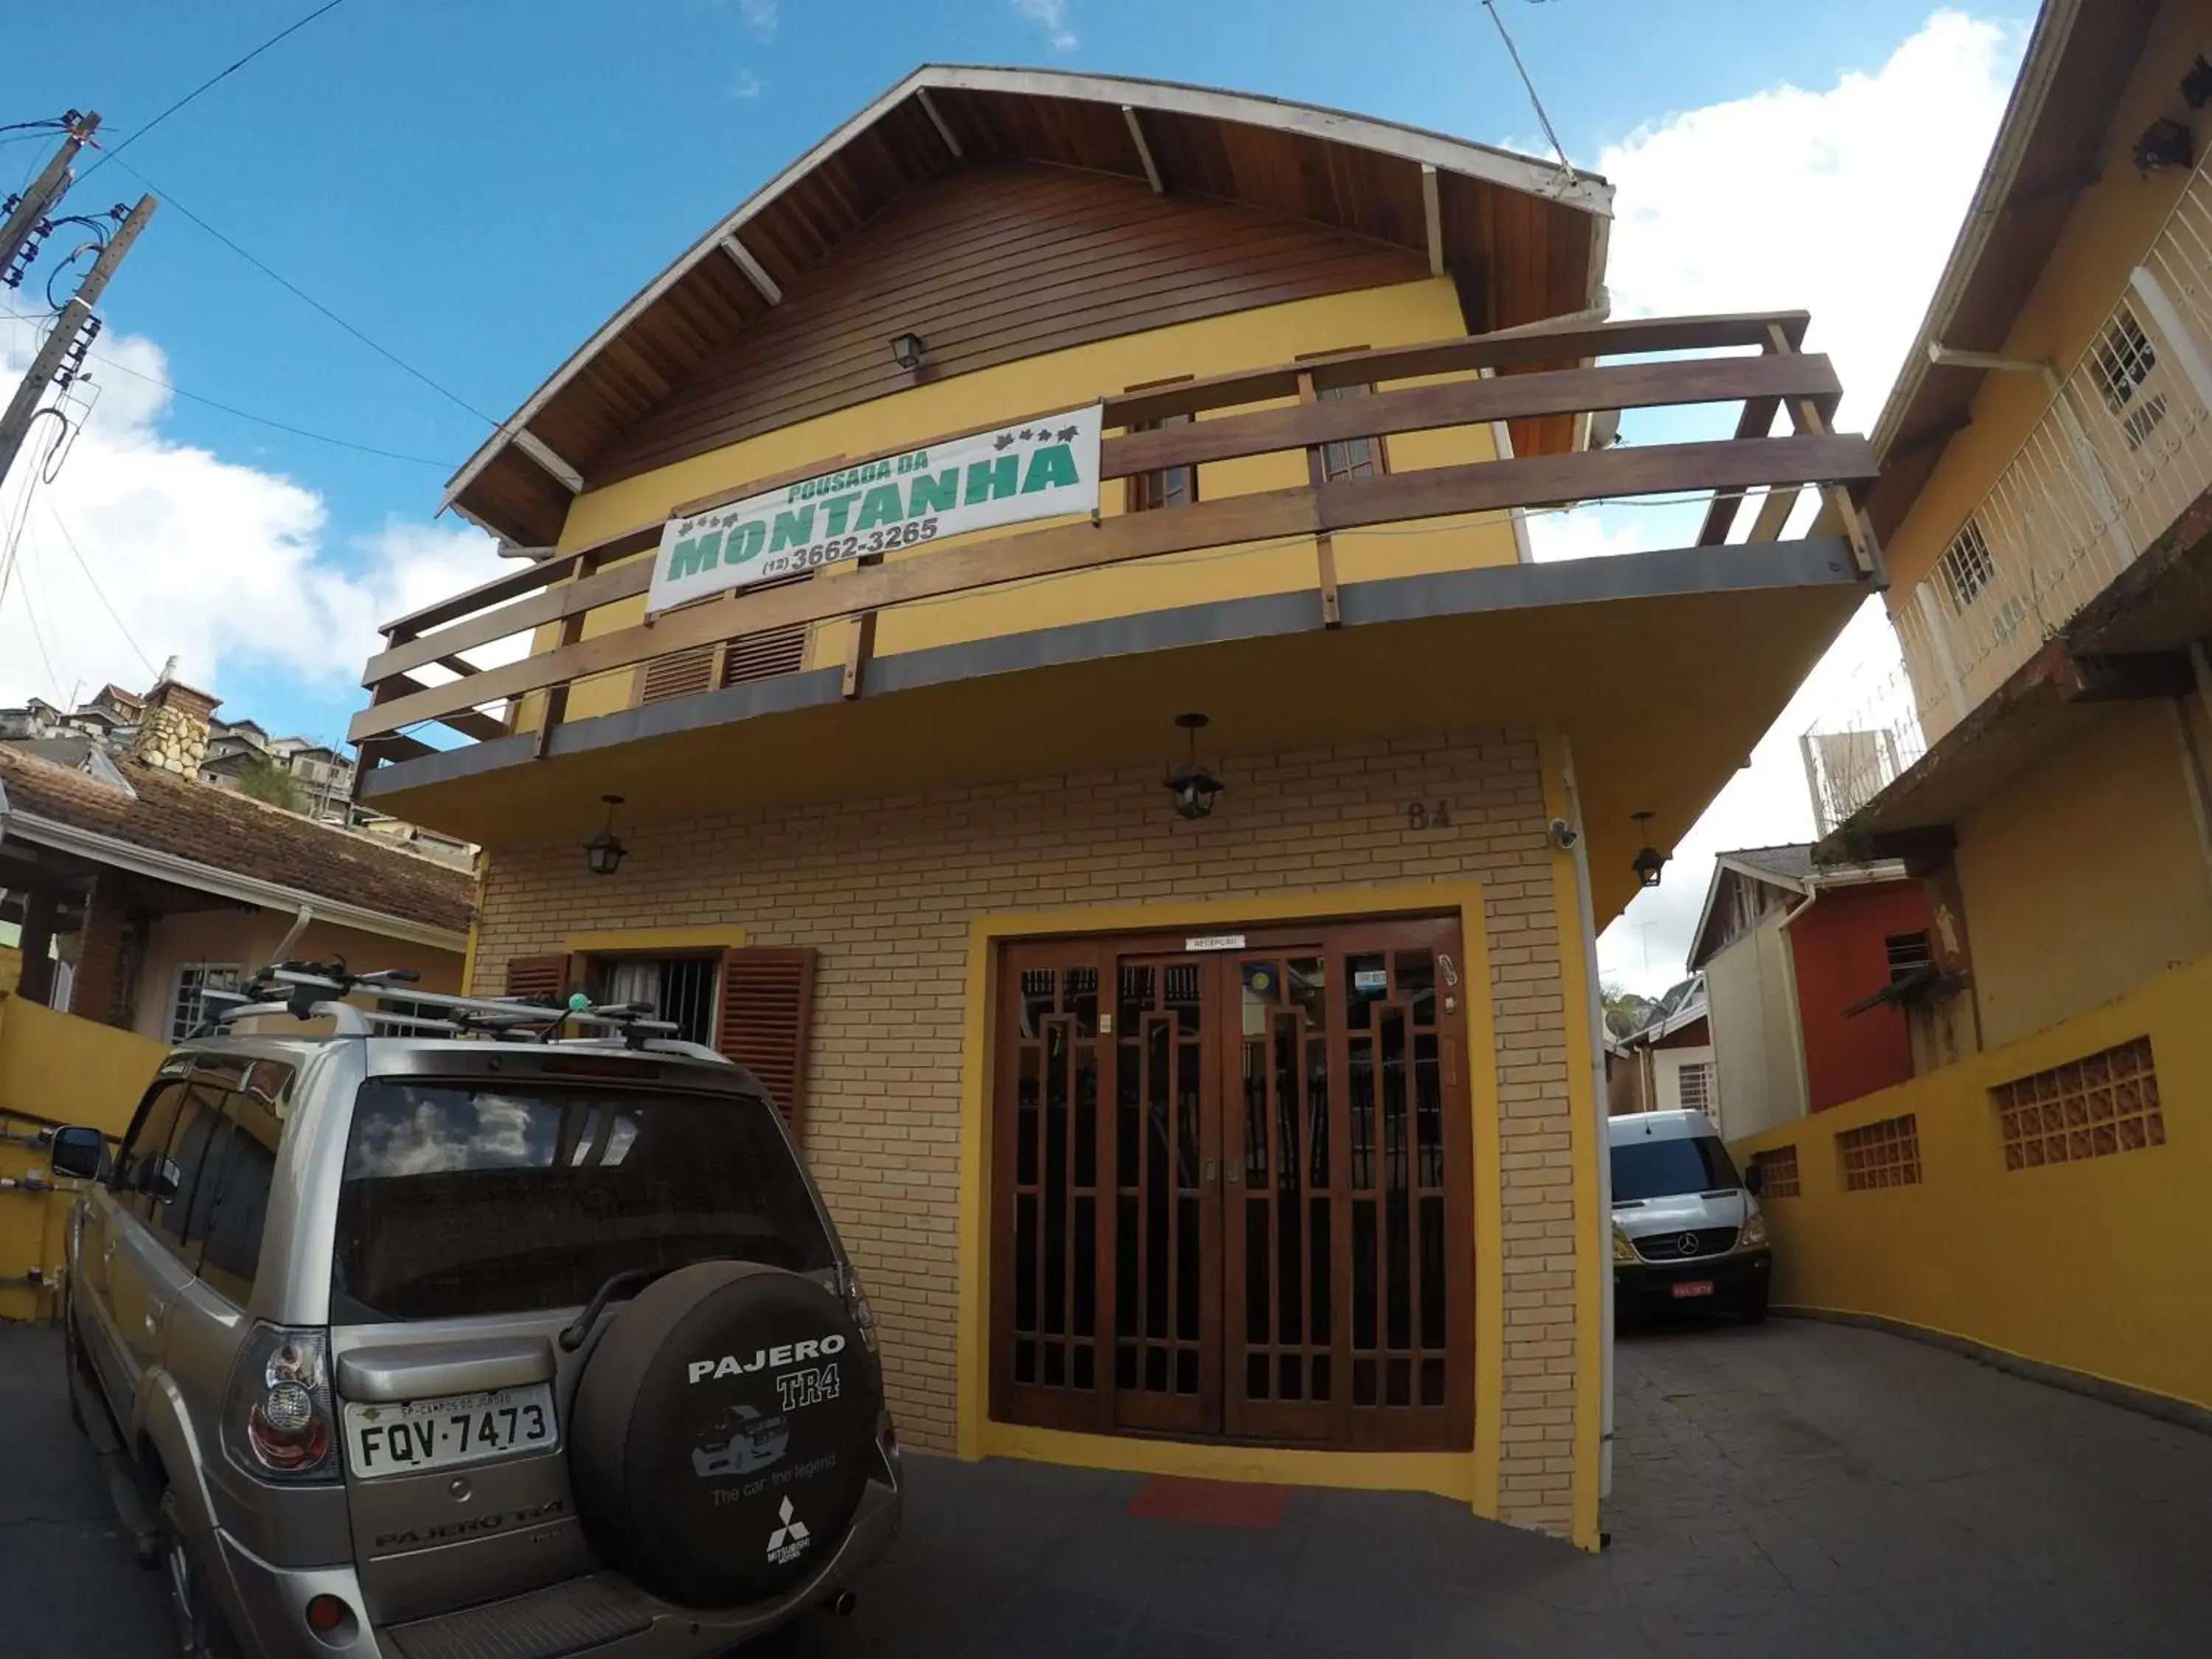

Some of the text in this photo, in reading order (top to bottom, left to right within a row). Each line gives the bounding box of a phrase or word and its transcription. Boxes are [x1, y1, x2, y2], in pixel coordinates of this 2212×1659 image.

[788, 451, 930, 504] POUSADA DA
[667, 443, 1080, 582] MONTANHA
[792, 518, 939, 571] 3662-3265
[688, 1334, 846, 1384] PAJERO
[776, 1363, 841, 1411] TR4
[710, 1488, 739, 1507] The
[375, 1514, 503, 1547] PAJERO
